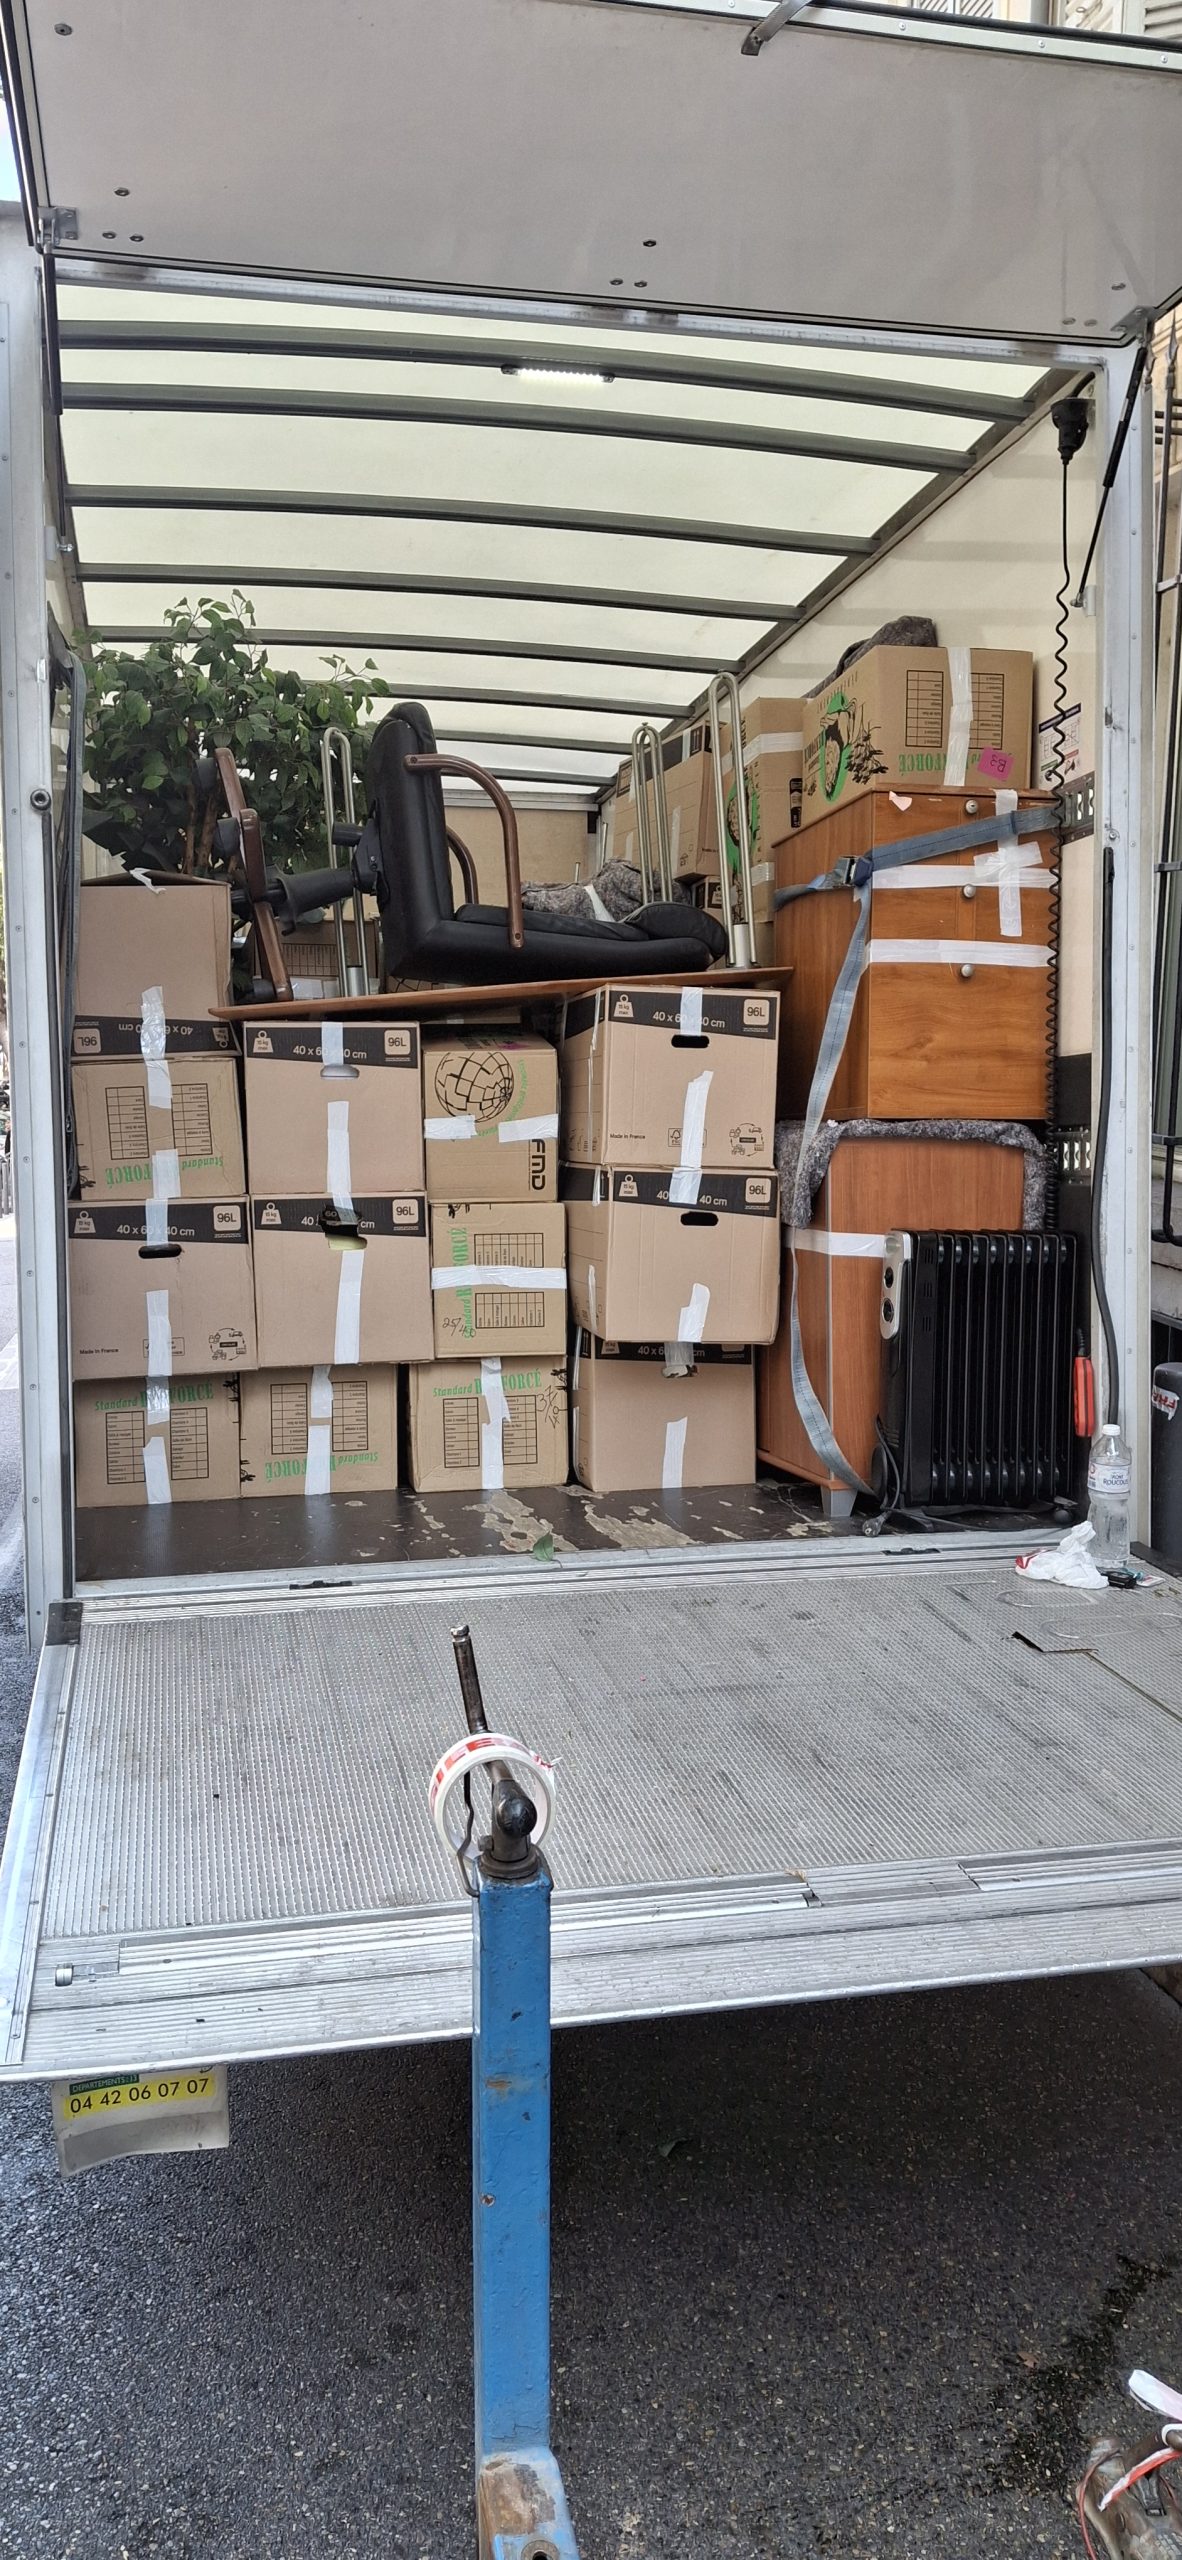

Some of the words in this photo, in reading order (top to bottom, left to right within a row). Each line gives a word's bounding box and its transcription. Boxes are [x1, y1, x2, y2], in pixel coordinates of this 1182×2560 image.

[746, 1006, 766, 1017] 96L
[652, 1012, 665, 1021] 40
[711, 1020, 725, 1028] cm
[78, 1036, 97, 1046] 96L
[388, 1037, 407, 1047] 96L
[293, 1046, 306, 1054] 40
[182, 1157, 224, 1170] Standard
[532, 1139, 545, 1190] FMD
[749, 1185, 766, 1195] 96L
[657, 1190, 669, 1200] 40
[700, 1195, 712, 1204] 40
[714, 1198, 728, 1206] cm
[396, 1206, 414, 1216] 96L
[217, 1213, 237, 1223] 96L
[301, 1216, 314, 1225] 40
[360, 1219, 375, 1228] cm
[116, 1225, 130, 1234] 40
[638, 1346, 649, 1355] 40
[432, 1384, 472, 1397] Standard
[95, 1396, 138, 1410] Standard
[339, 1452, 378, 1465] Standard
[70, 2097, 92, 2113] 04
[100, 2090, 121, 2105] 42
[129, 2085, 151, 2101] 06
[158, 2082, 180, 2097] 07
[187, 2079, 209, 2093] 07
